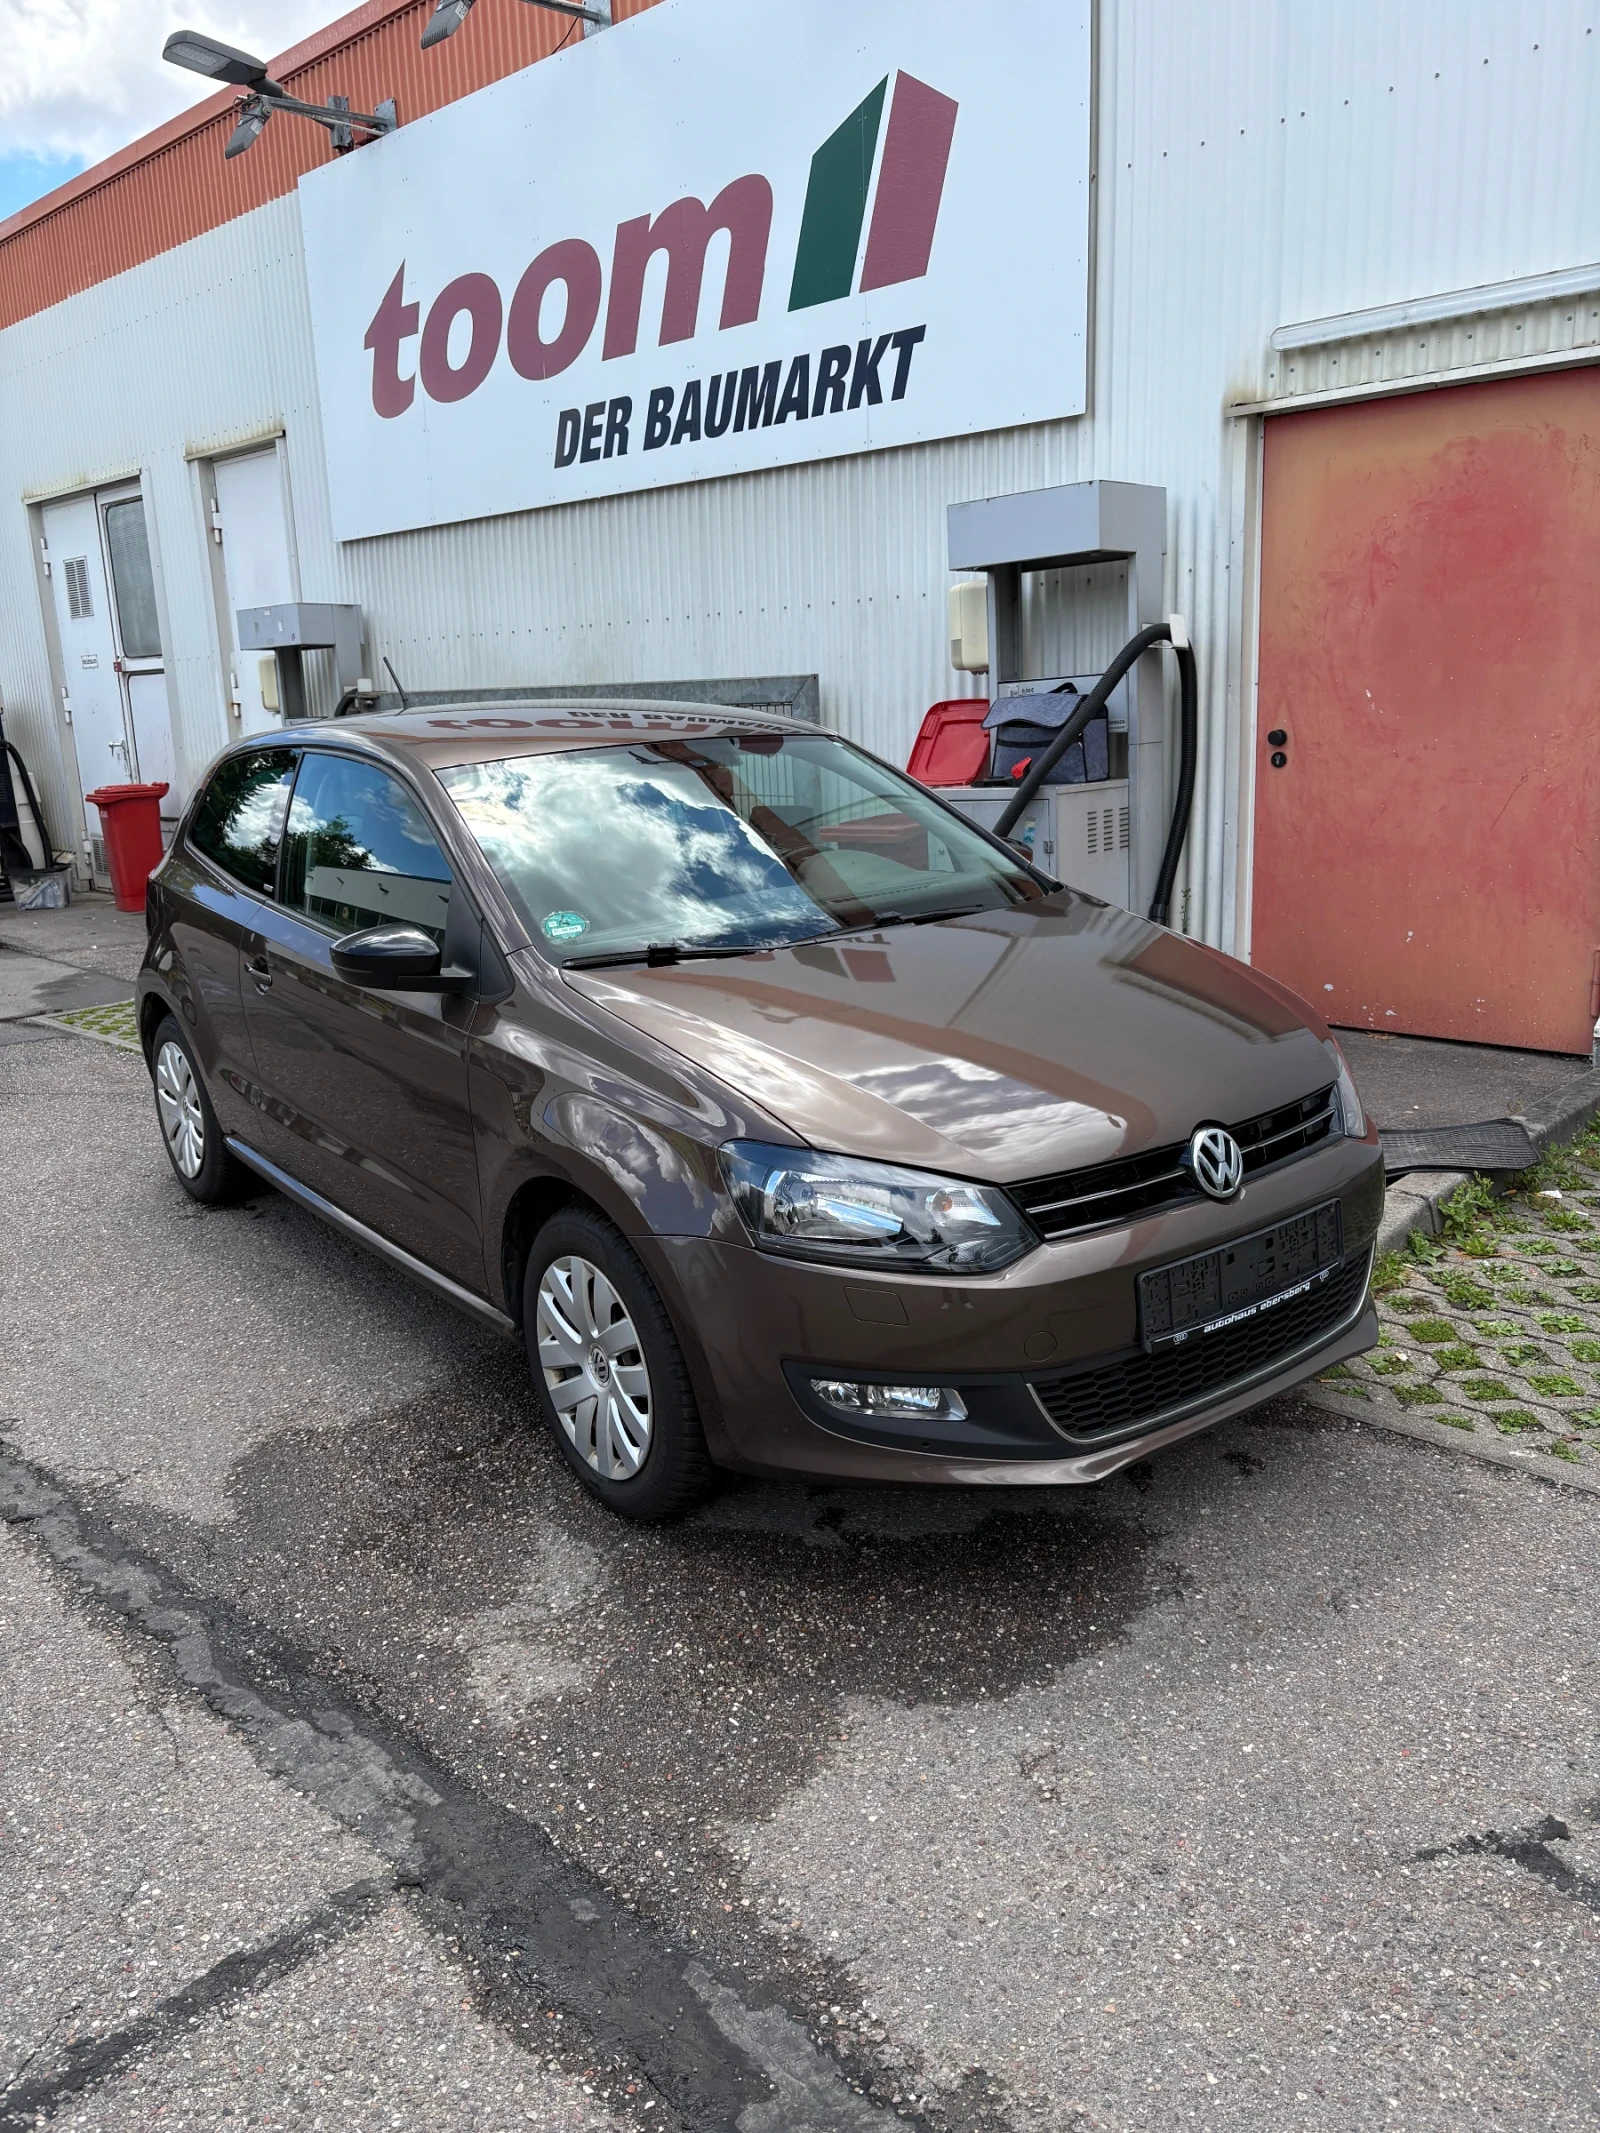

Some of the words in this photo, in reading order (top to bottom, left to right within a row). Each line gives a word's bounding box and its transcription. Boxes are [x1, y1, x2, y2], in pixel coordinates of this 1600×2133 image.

[364, 173, 774, 419] toom
[554, 397, 630, 469] DER
[643, 324, 927, 451] BAUMARKT
[1194, 1130, 1241, 1196] VW
[1203, 1307, 1257, 1333] autohaus
[1260, 1282, 1311, 1311] ebersberg
